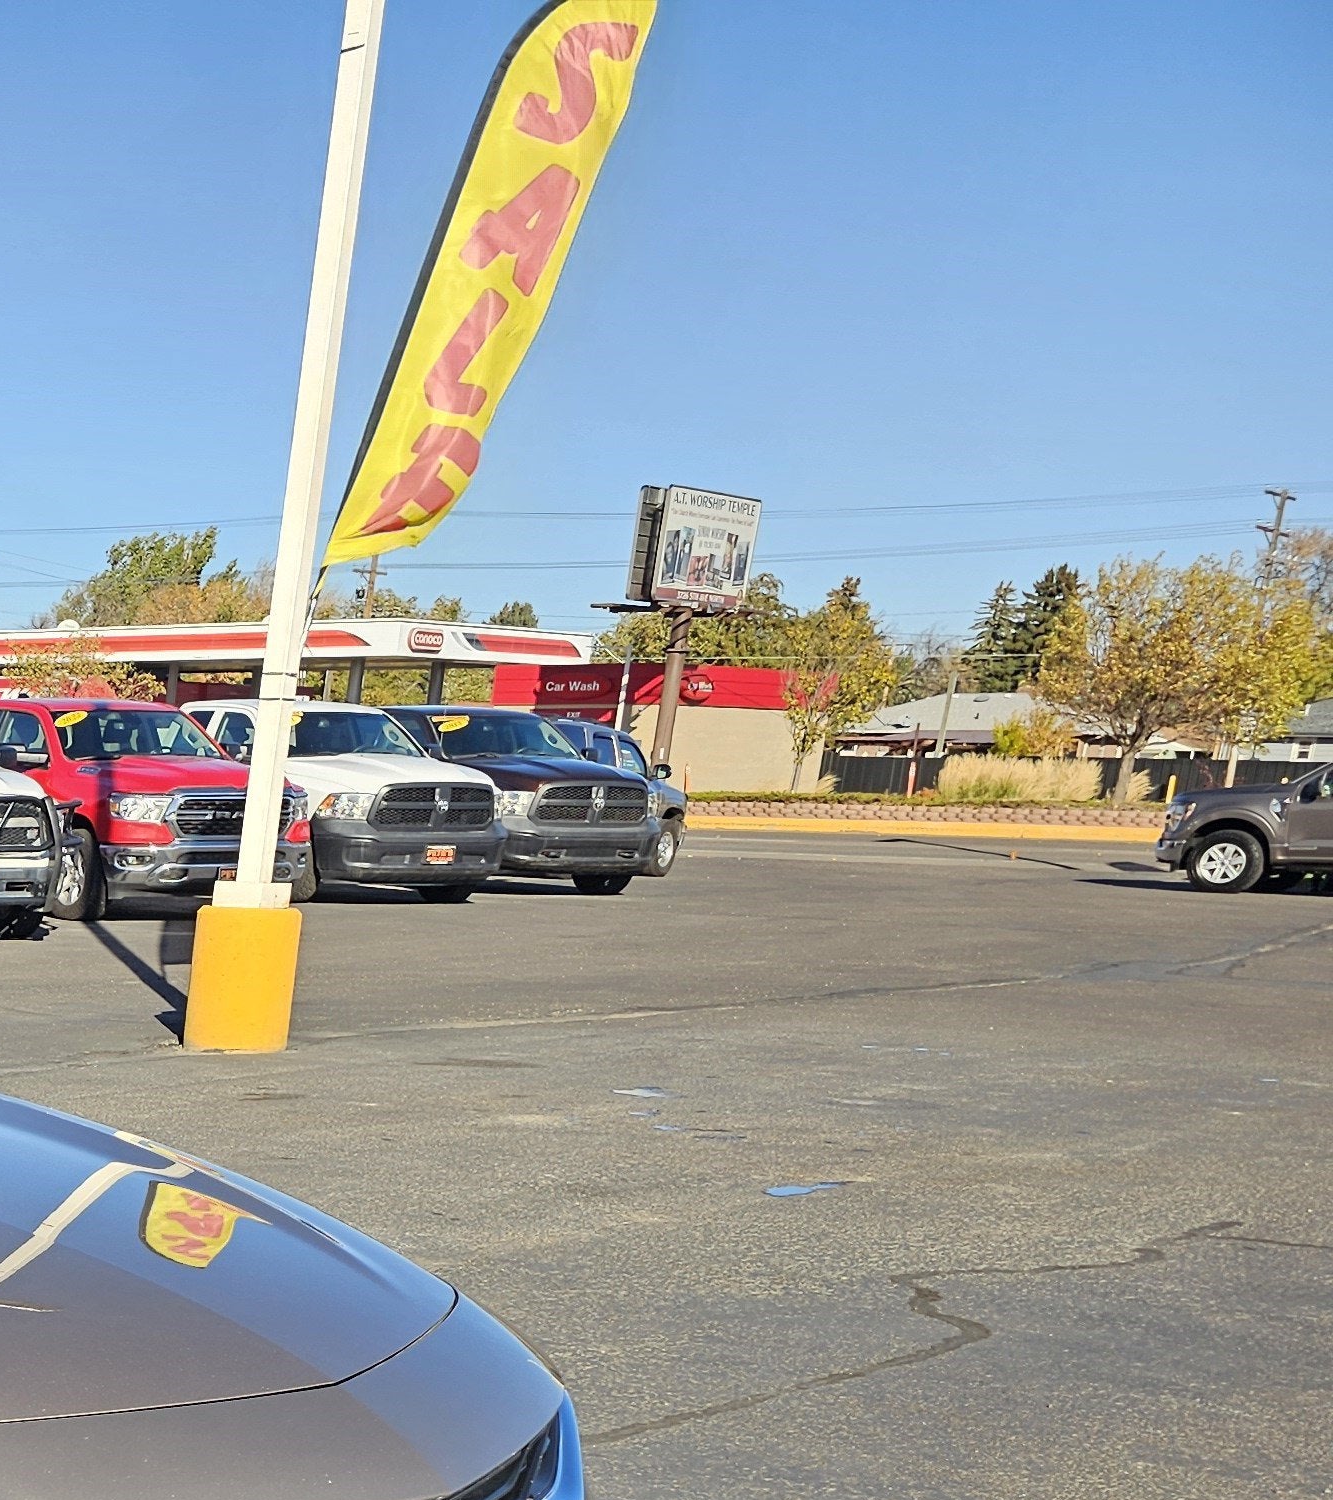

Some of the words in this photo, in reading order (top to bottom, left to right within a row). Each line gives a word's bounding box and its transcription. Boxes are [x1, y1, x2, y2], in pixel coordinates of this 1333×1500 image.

[690, 493, 726, 511] WORSHIP
[728, 500, 756, 517] TEMPLE
[546, 681, 565, 691] Car
[569, 681, 600, 691] Wash
